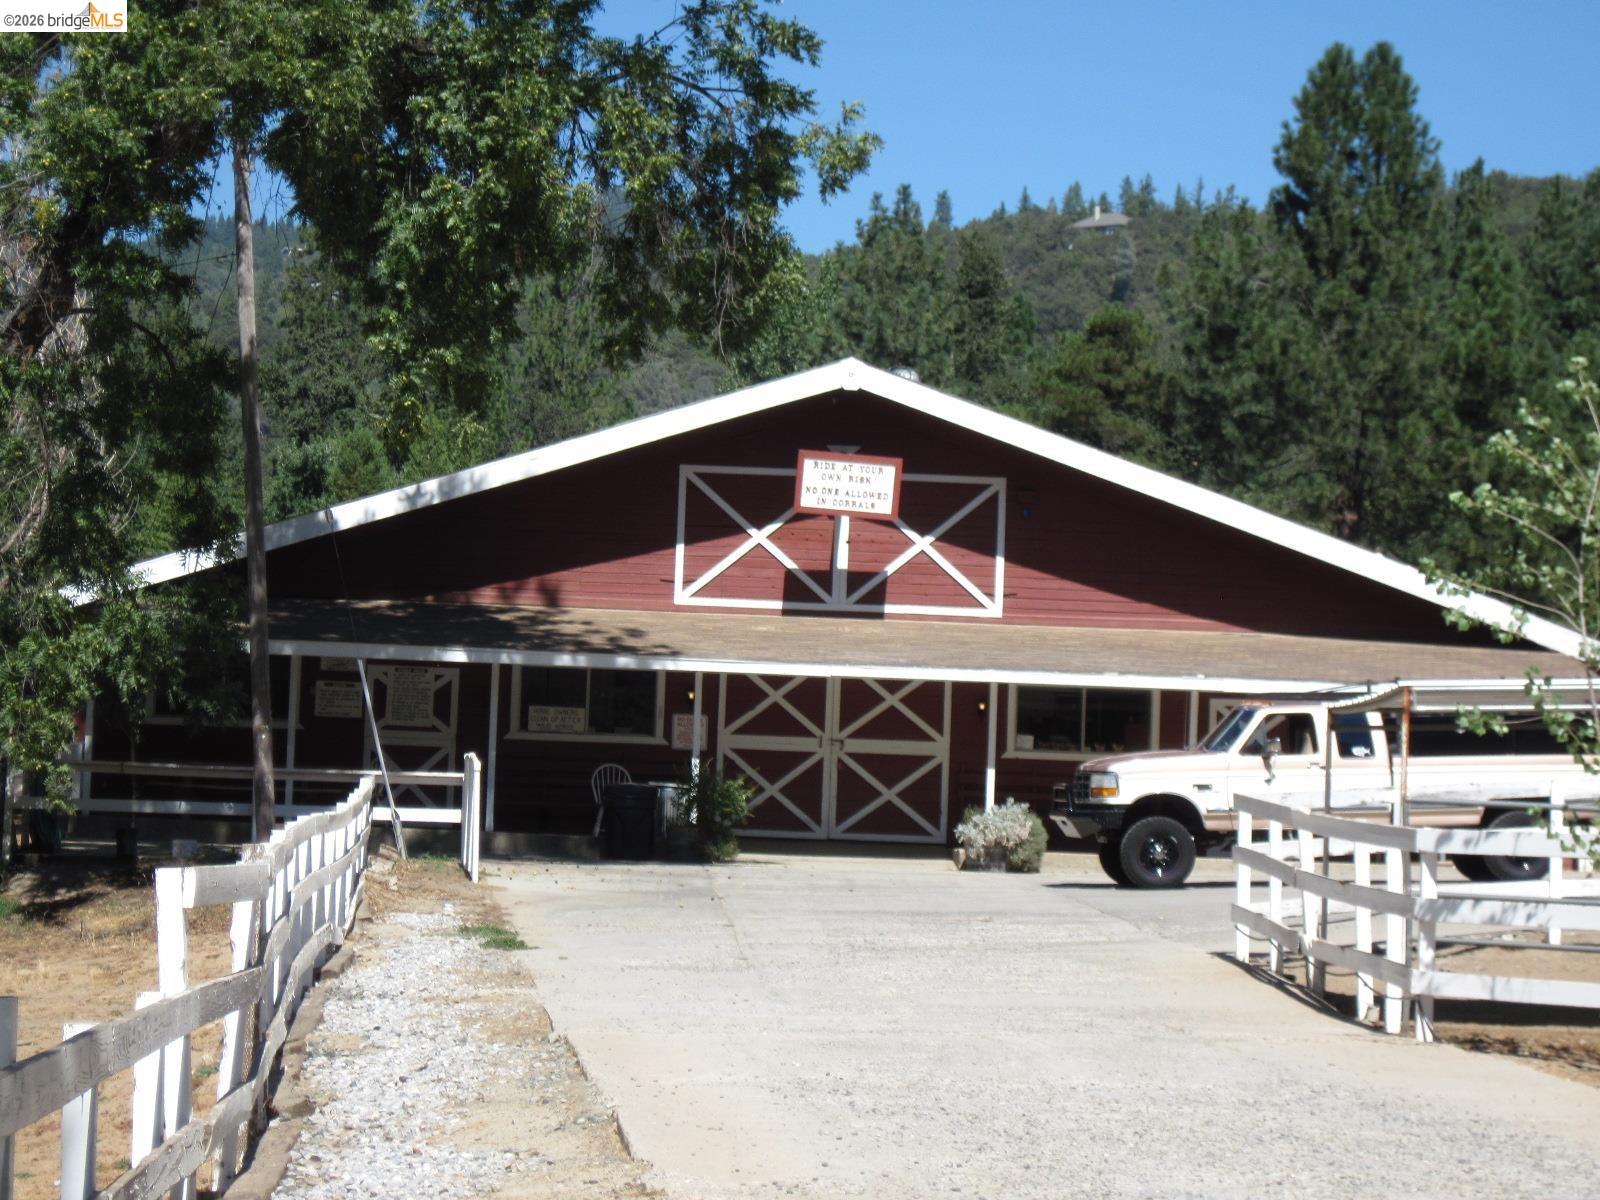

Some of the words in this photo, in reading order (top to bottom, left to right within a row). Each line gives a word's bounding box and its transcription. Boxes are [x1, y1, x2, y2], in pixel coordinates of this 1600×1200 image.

[814, 461, 835, 470] RIDE
[860, 466, 883, 474] YOUR
[821, 473, 841, 481] OWN
[848, 476, 871, 484] RISK
[805, 486, 818, 494] NO
[821, 487, 839, 496] ONE
[845, 490, 889, 500] ALLOWED
[817, 497, 826, 505] IN
[832, 499, 876, 509] CORRALS
